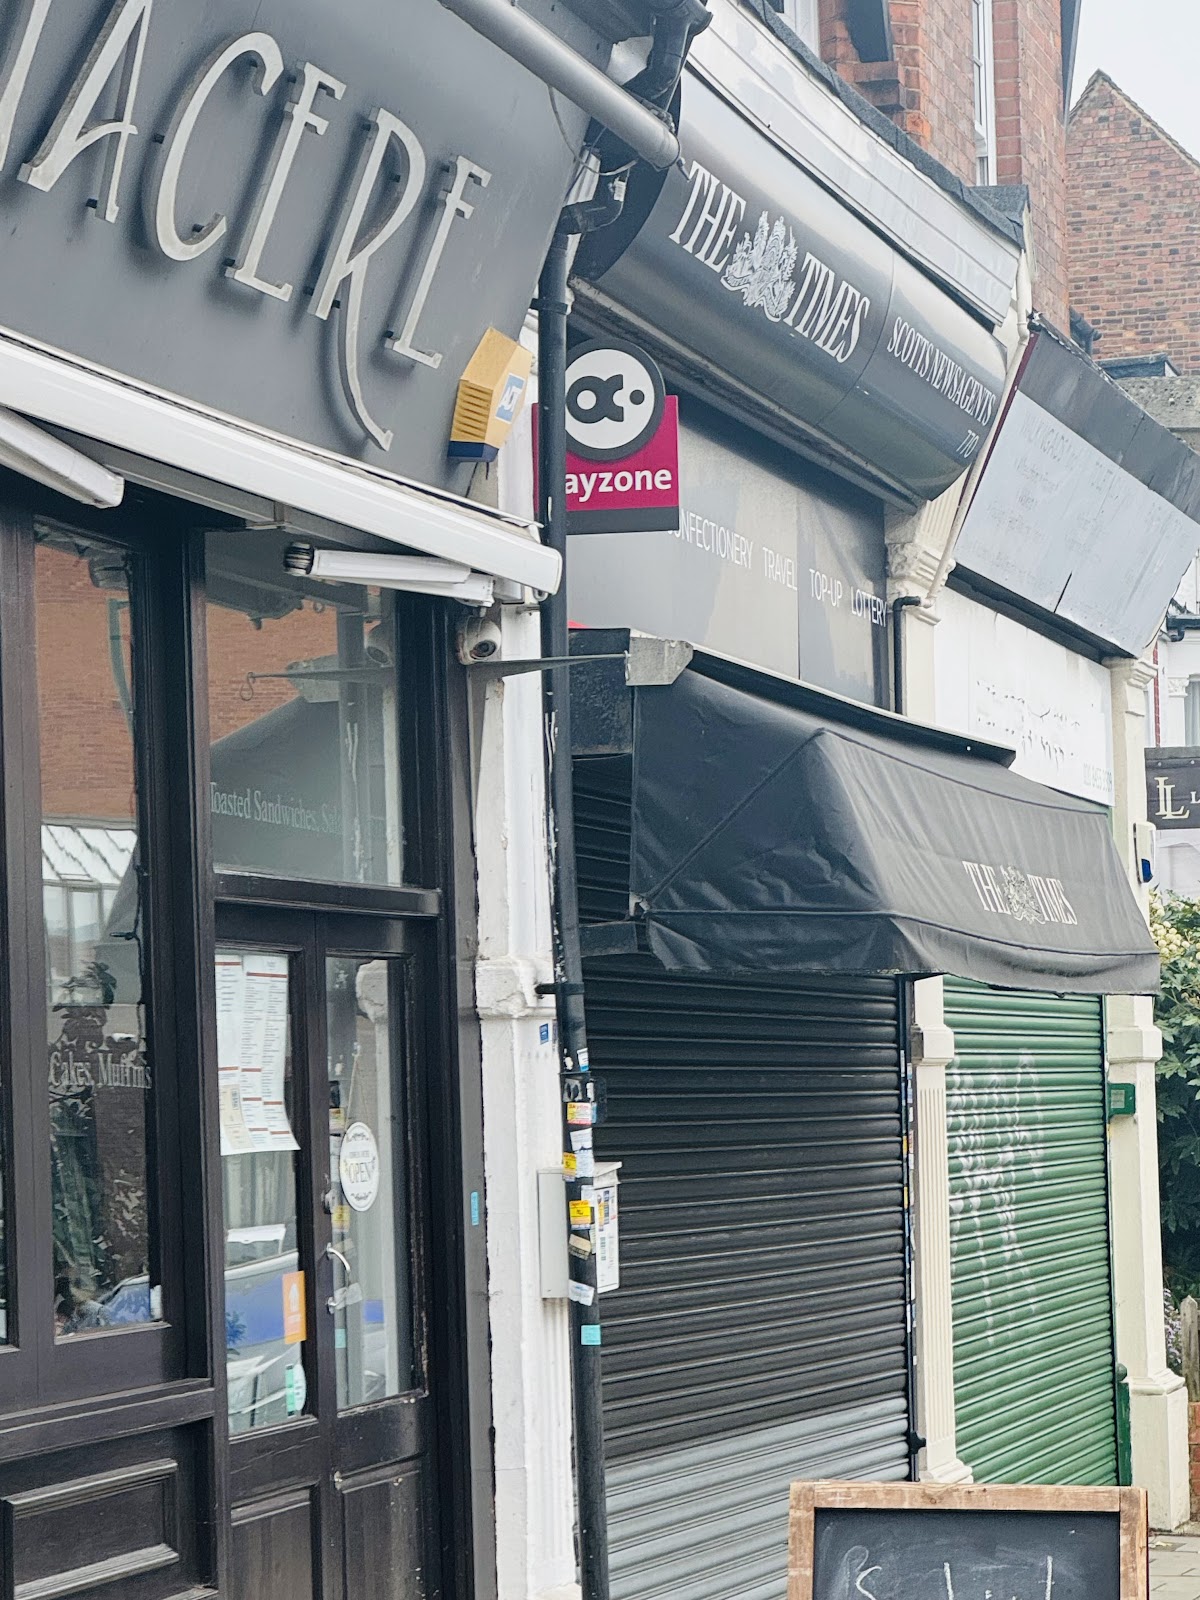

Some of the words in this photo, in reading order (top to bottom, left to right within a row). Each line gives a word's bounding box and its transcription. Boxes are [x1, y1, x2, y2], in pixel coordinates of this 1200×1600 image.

[669, 160, 747, 273] THE
[783, 252, 870, 363] TIMES
[887, 316, 934, 378] SCOTTS
[926, 348, 997, 426] NEWSAGENTS
[956, 429, 980, 459] 770
[566, 468, 673, 503] ayzone
[667, 508, 753, 569] NFECTIONERY
[763, 547, 798, 591] TRAVEL
[809, 568, 843, 608] TOP-UP
[850, 586, 888, 628] LOTTERY
[210, 781, 251, 819] Toasted
[962, 860, 1012, 915] THE
[1026, 873, 1078, 926] TIMES
